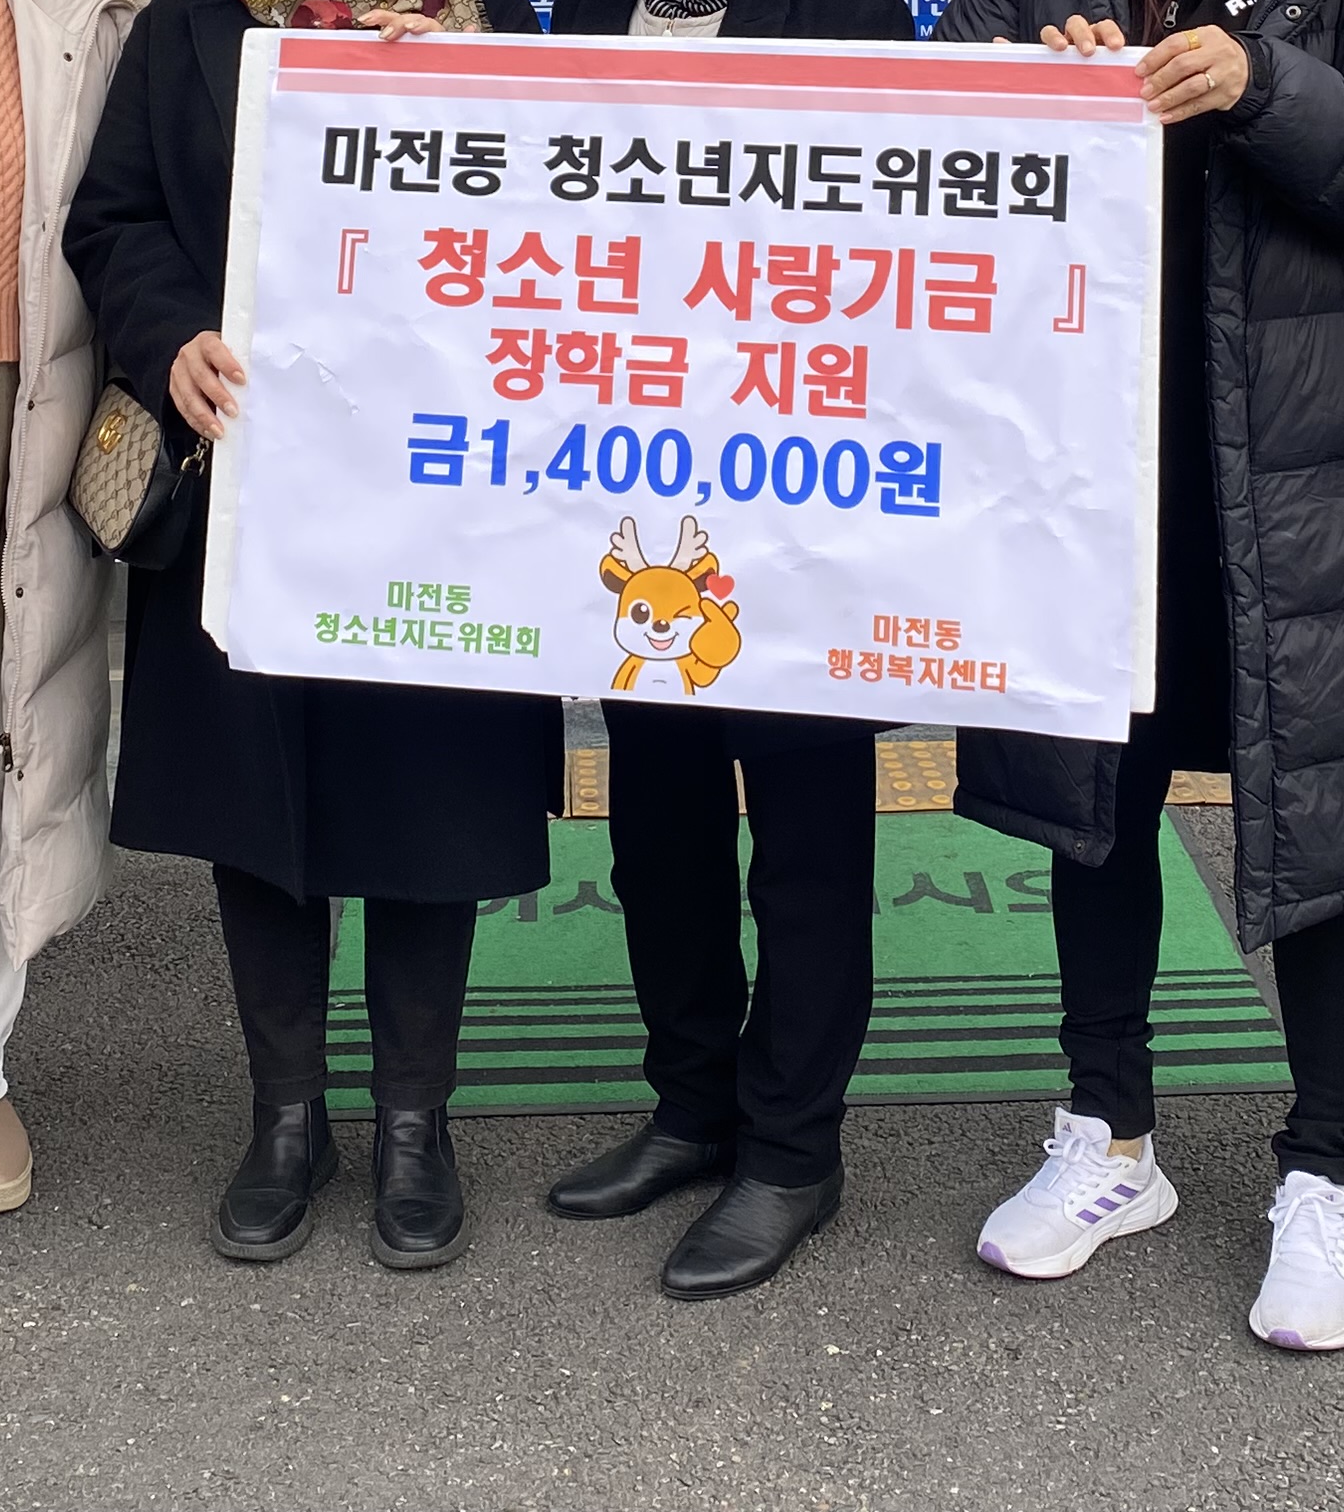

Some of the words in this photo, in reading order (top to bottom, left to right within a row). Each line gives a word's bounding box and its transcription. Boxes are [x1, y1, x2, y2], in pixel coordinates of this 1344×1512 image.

[322, 127, 507, 196] 마전동
[544, 135, 1069, 223] 청소년지도위원회
[418, 227, 642, 314] 청소년
[683, 241, 998, 333] 사랑기금
[486, 328, 689, 408] 장학금
[731, 341, 869, 419] 지원
[407, 412, 943, 518] 금1,400,000원
[387, 581, 472, 616] 마전동
[871, 614, 963, 651] 마전동
[314, 612, 542, 658] 청소년지도위원회
[826, 647, 1008, 694] 행정복지센터
